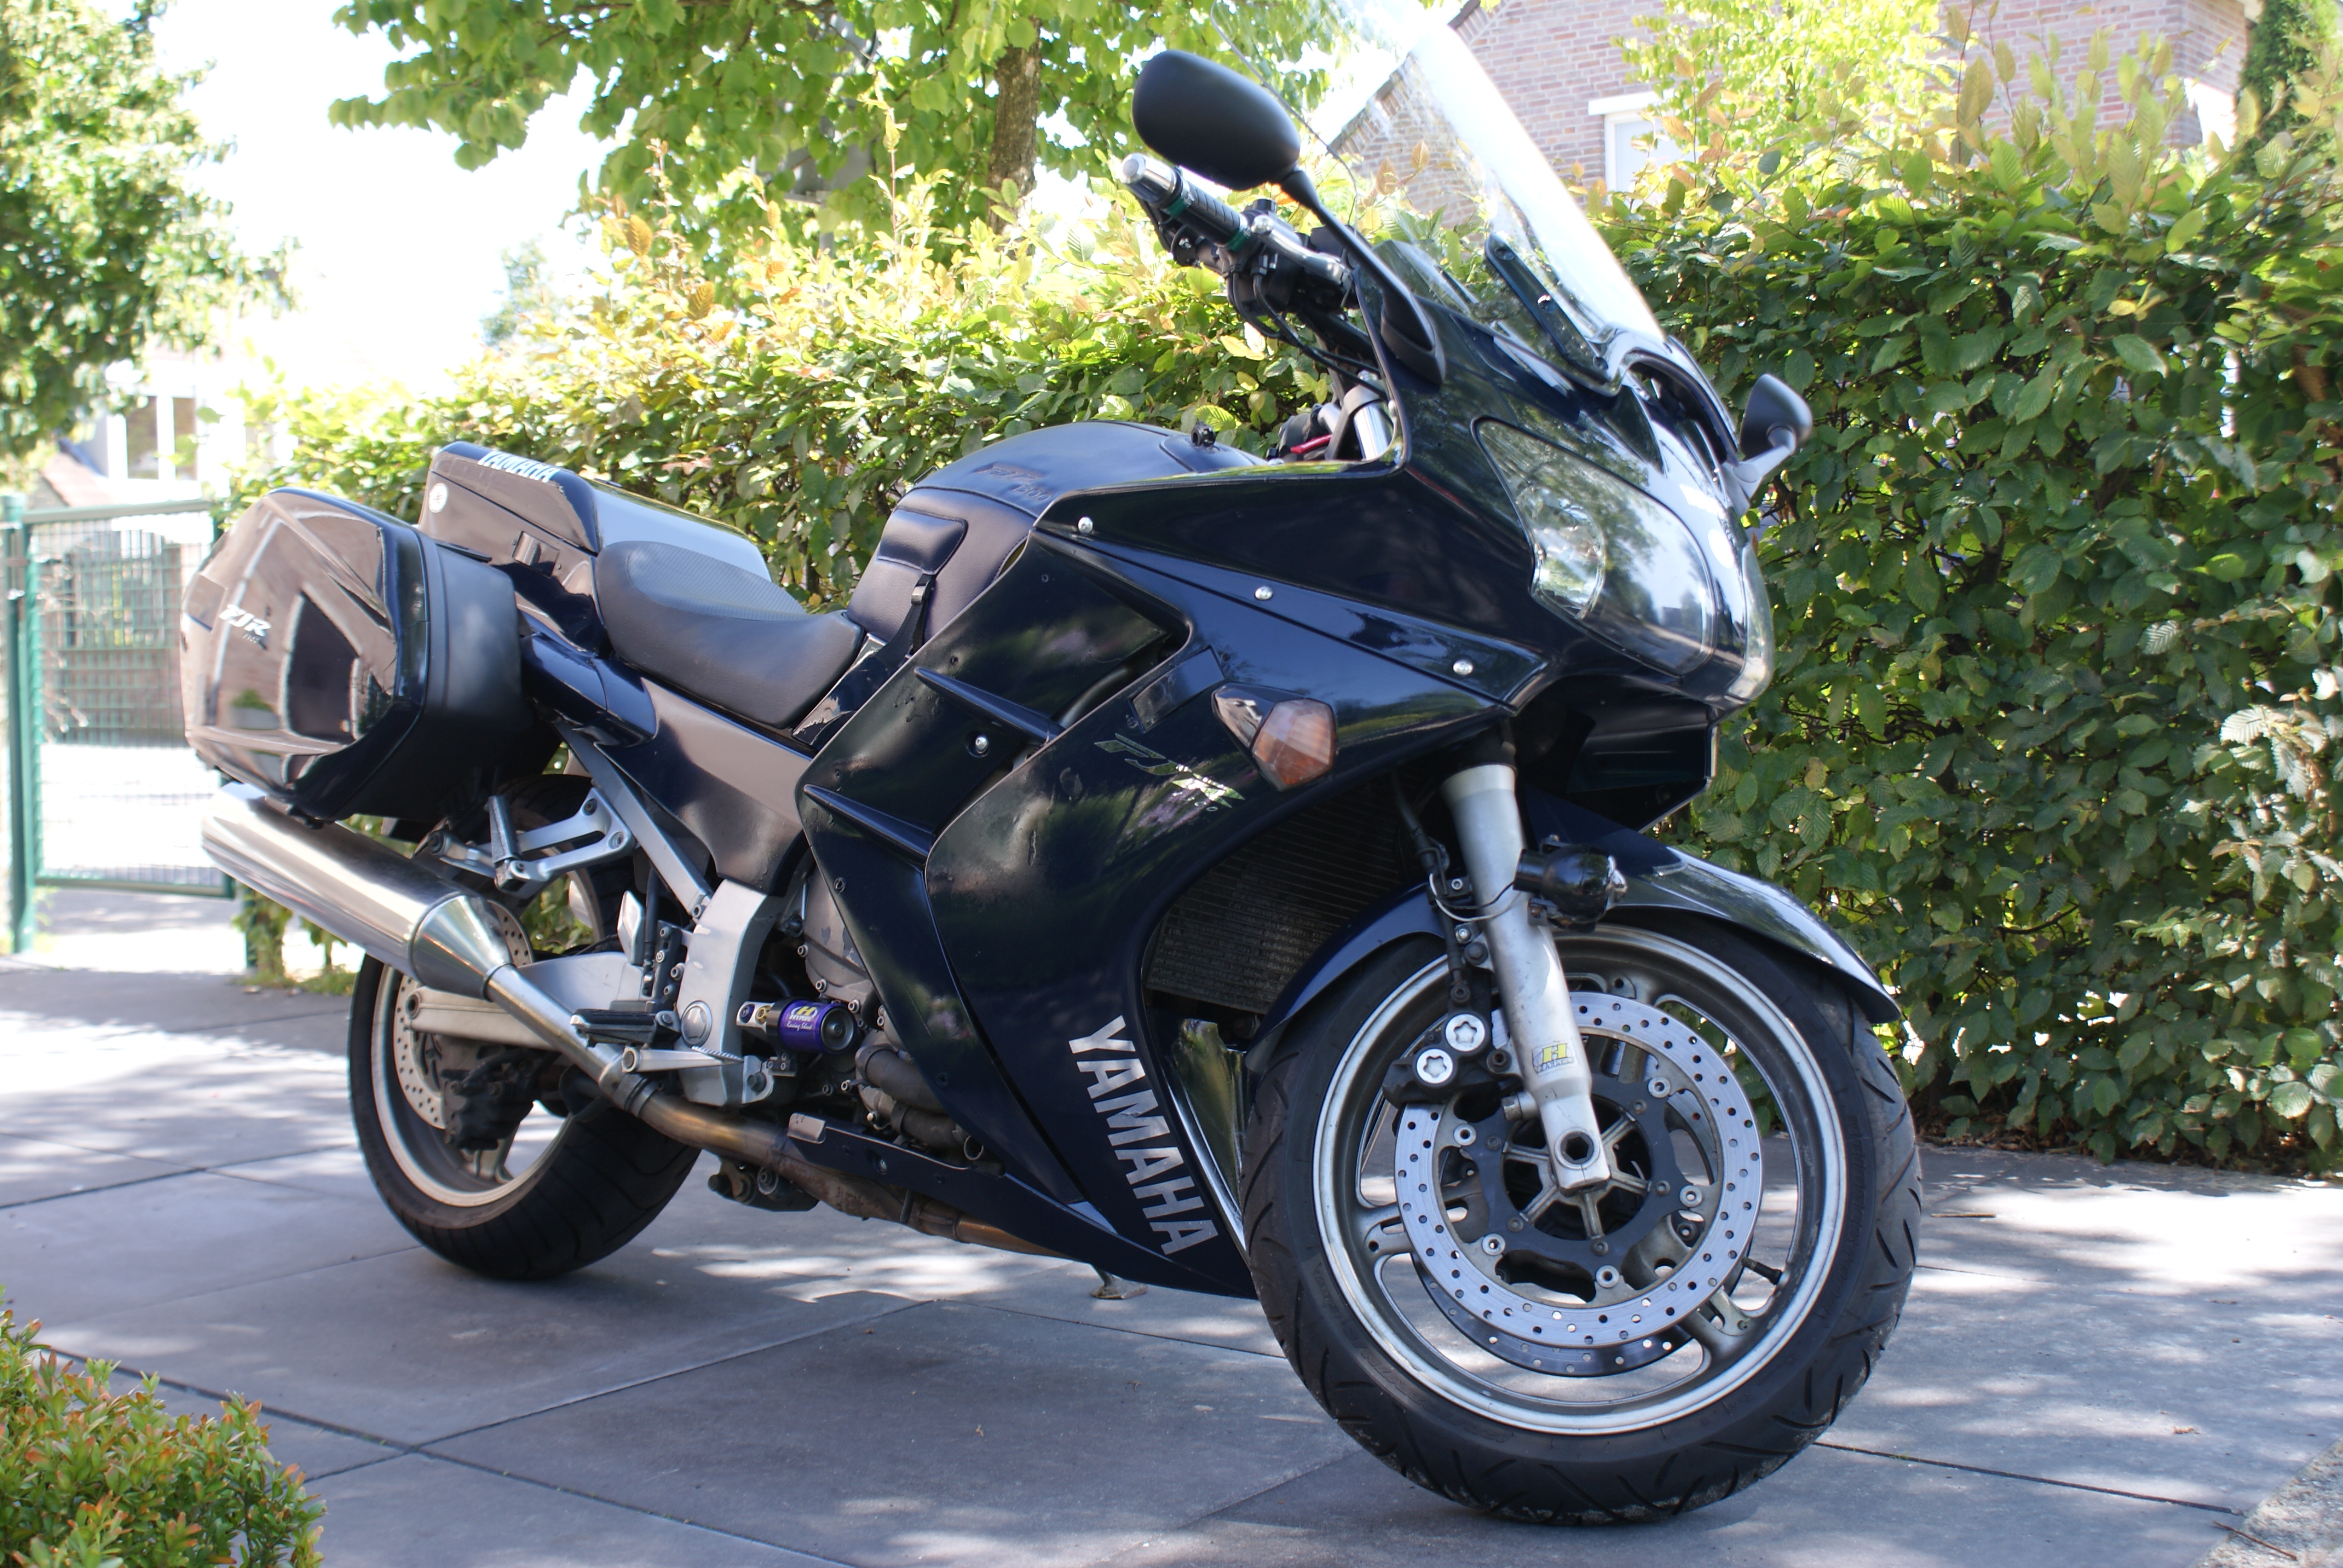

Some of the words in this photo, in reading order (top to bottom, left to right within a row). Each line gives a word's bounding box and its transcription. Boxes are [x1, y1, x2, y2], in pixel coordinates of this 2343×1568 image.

[477, 451, 560, 483] YAMAHA
[218, 604, 272, 637] FJR
[1093, 733, 1245, 808] FJR
[1068, 1014, 1219, 1255] YAMAHA
